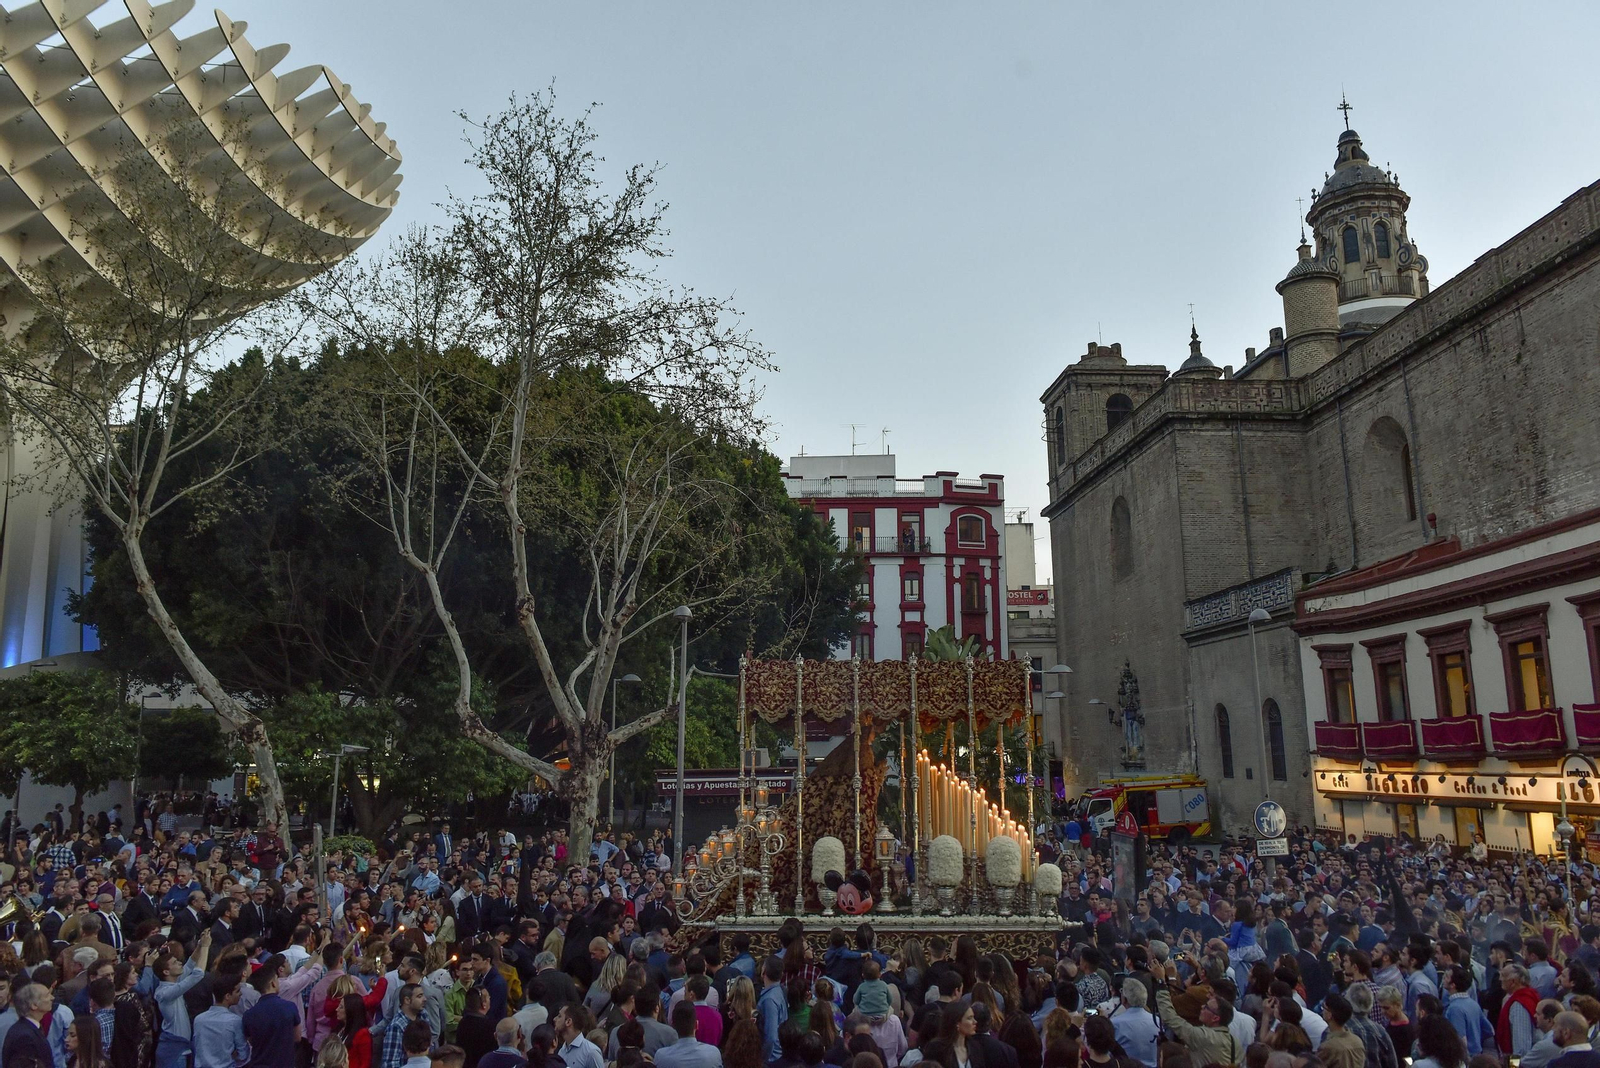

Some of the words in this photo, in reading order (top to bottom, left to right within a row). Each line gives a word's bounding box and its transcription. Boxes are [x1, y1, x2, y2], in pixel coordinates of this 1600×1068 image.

[697, 782, 702, 791] y
[704, 781, 740, 790] Apuesta
[1454, 780, 1487, 794] Coffee
[1492, 782, 1498, 794] &
[1503, 782, 1528, 796] Food
